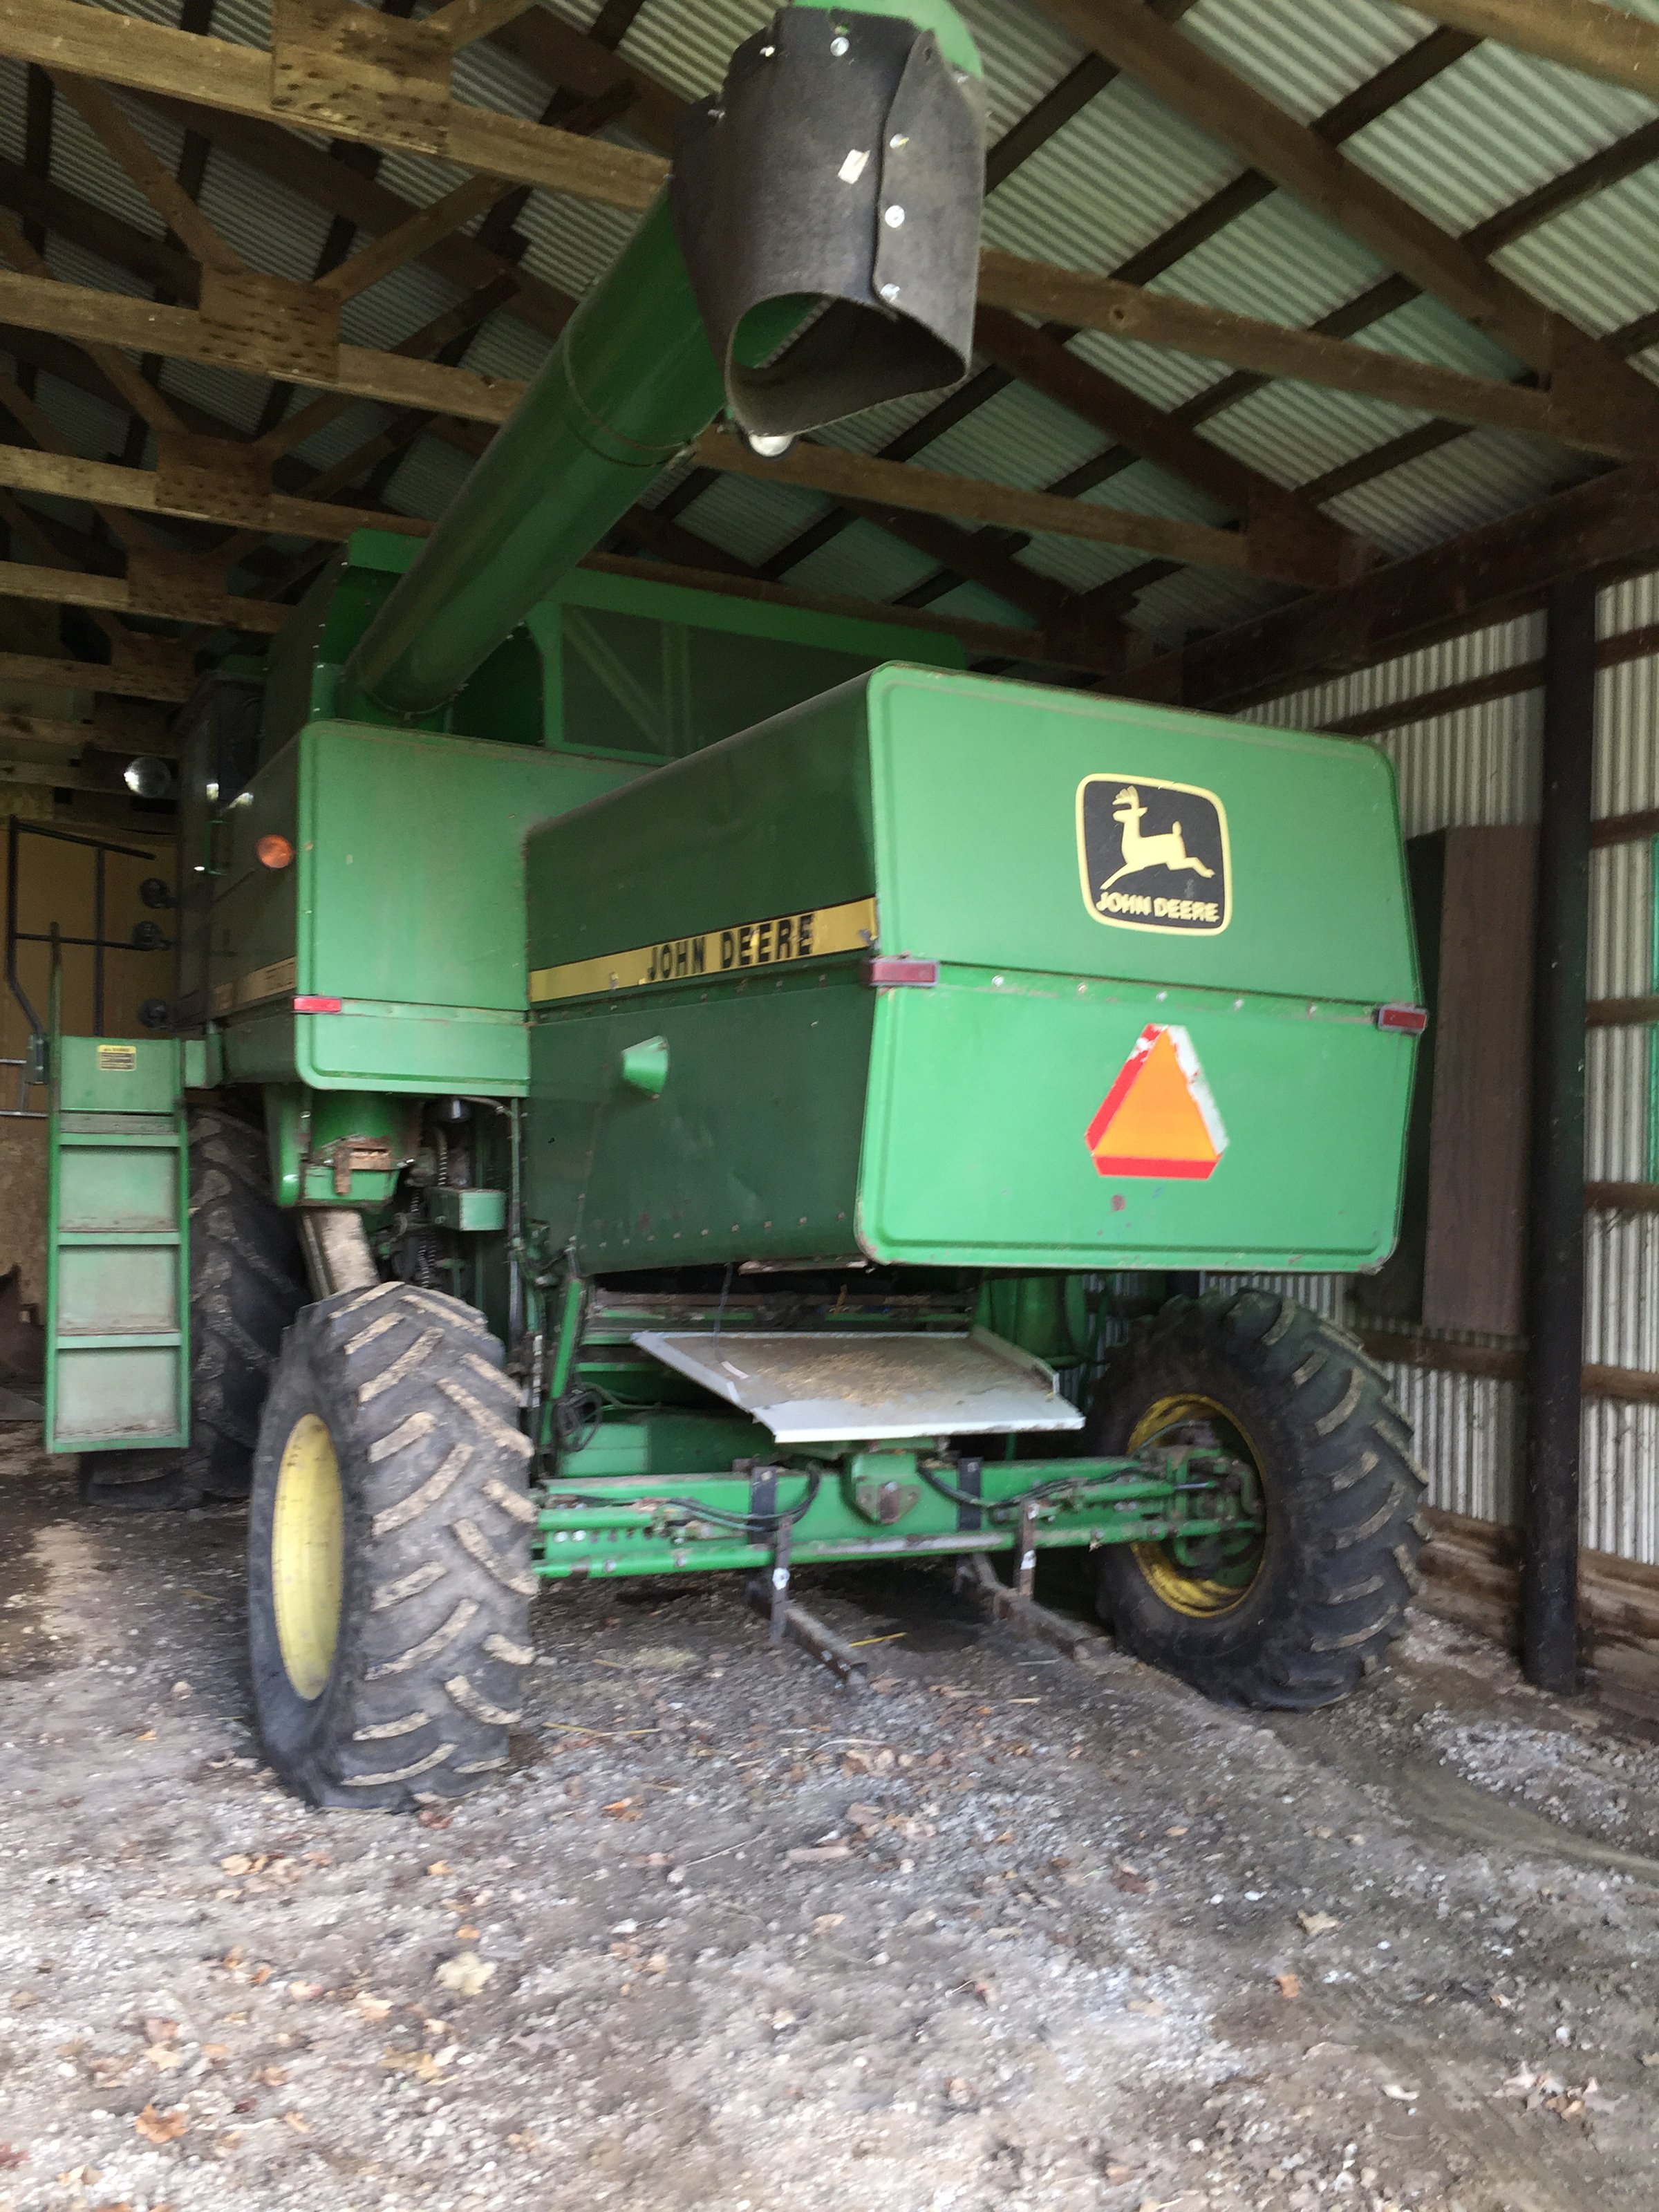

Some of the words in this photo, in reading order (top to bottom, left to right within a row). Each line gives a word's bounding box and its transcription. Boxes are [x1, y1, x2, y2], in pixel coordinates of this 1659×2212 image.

[1096, 892, 1152, 915] JOHN
[1154, 897, 1219, 922] DEERE
[648, 937, 705, 980] JOHN
[722, 914, 813, 968] DEERE
